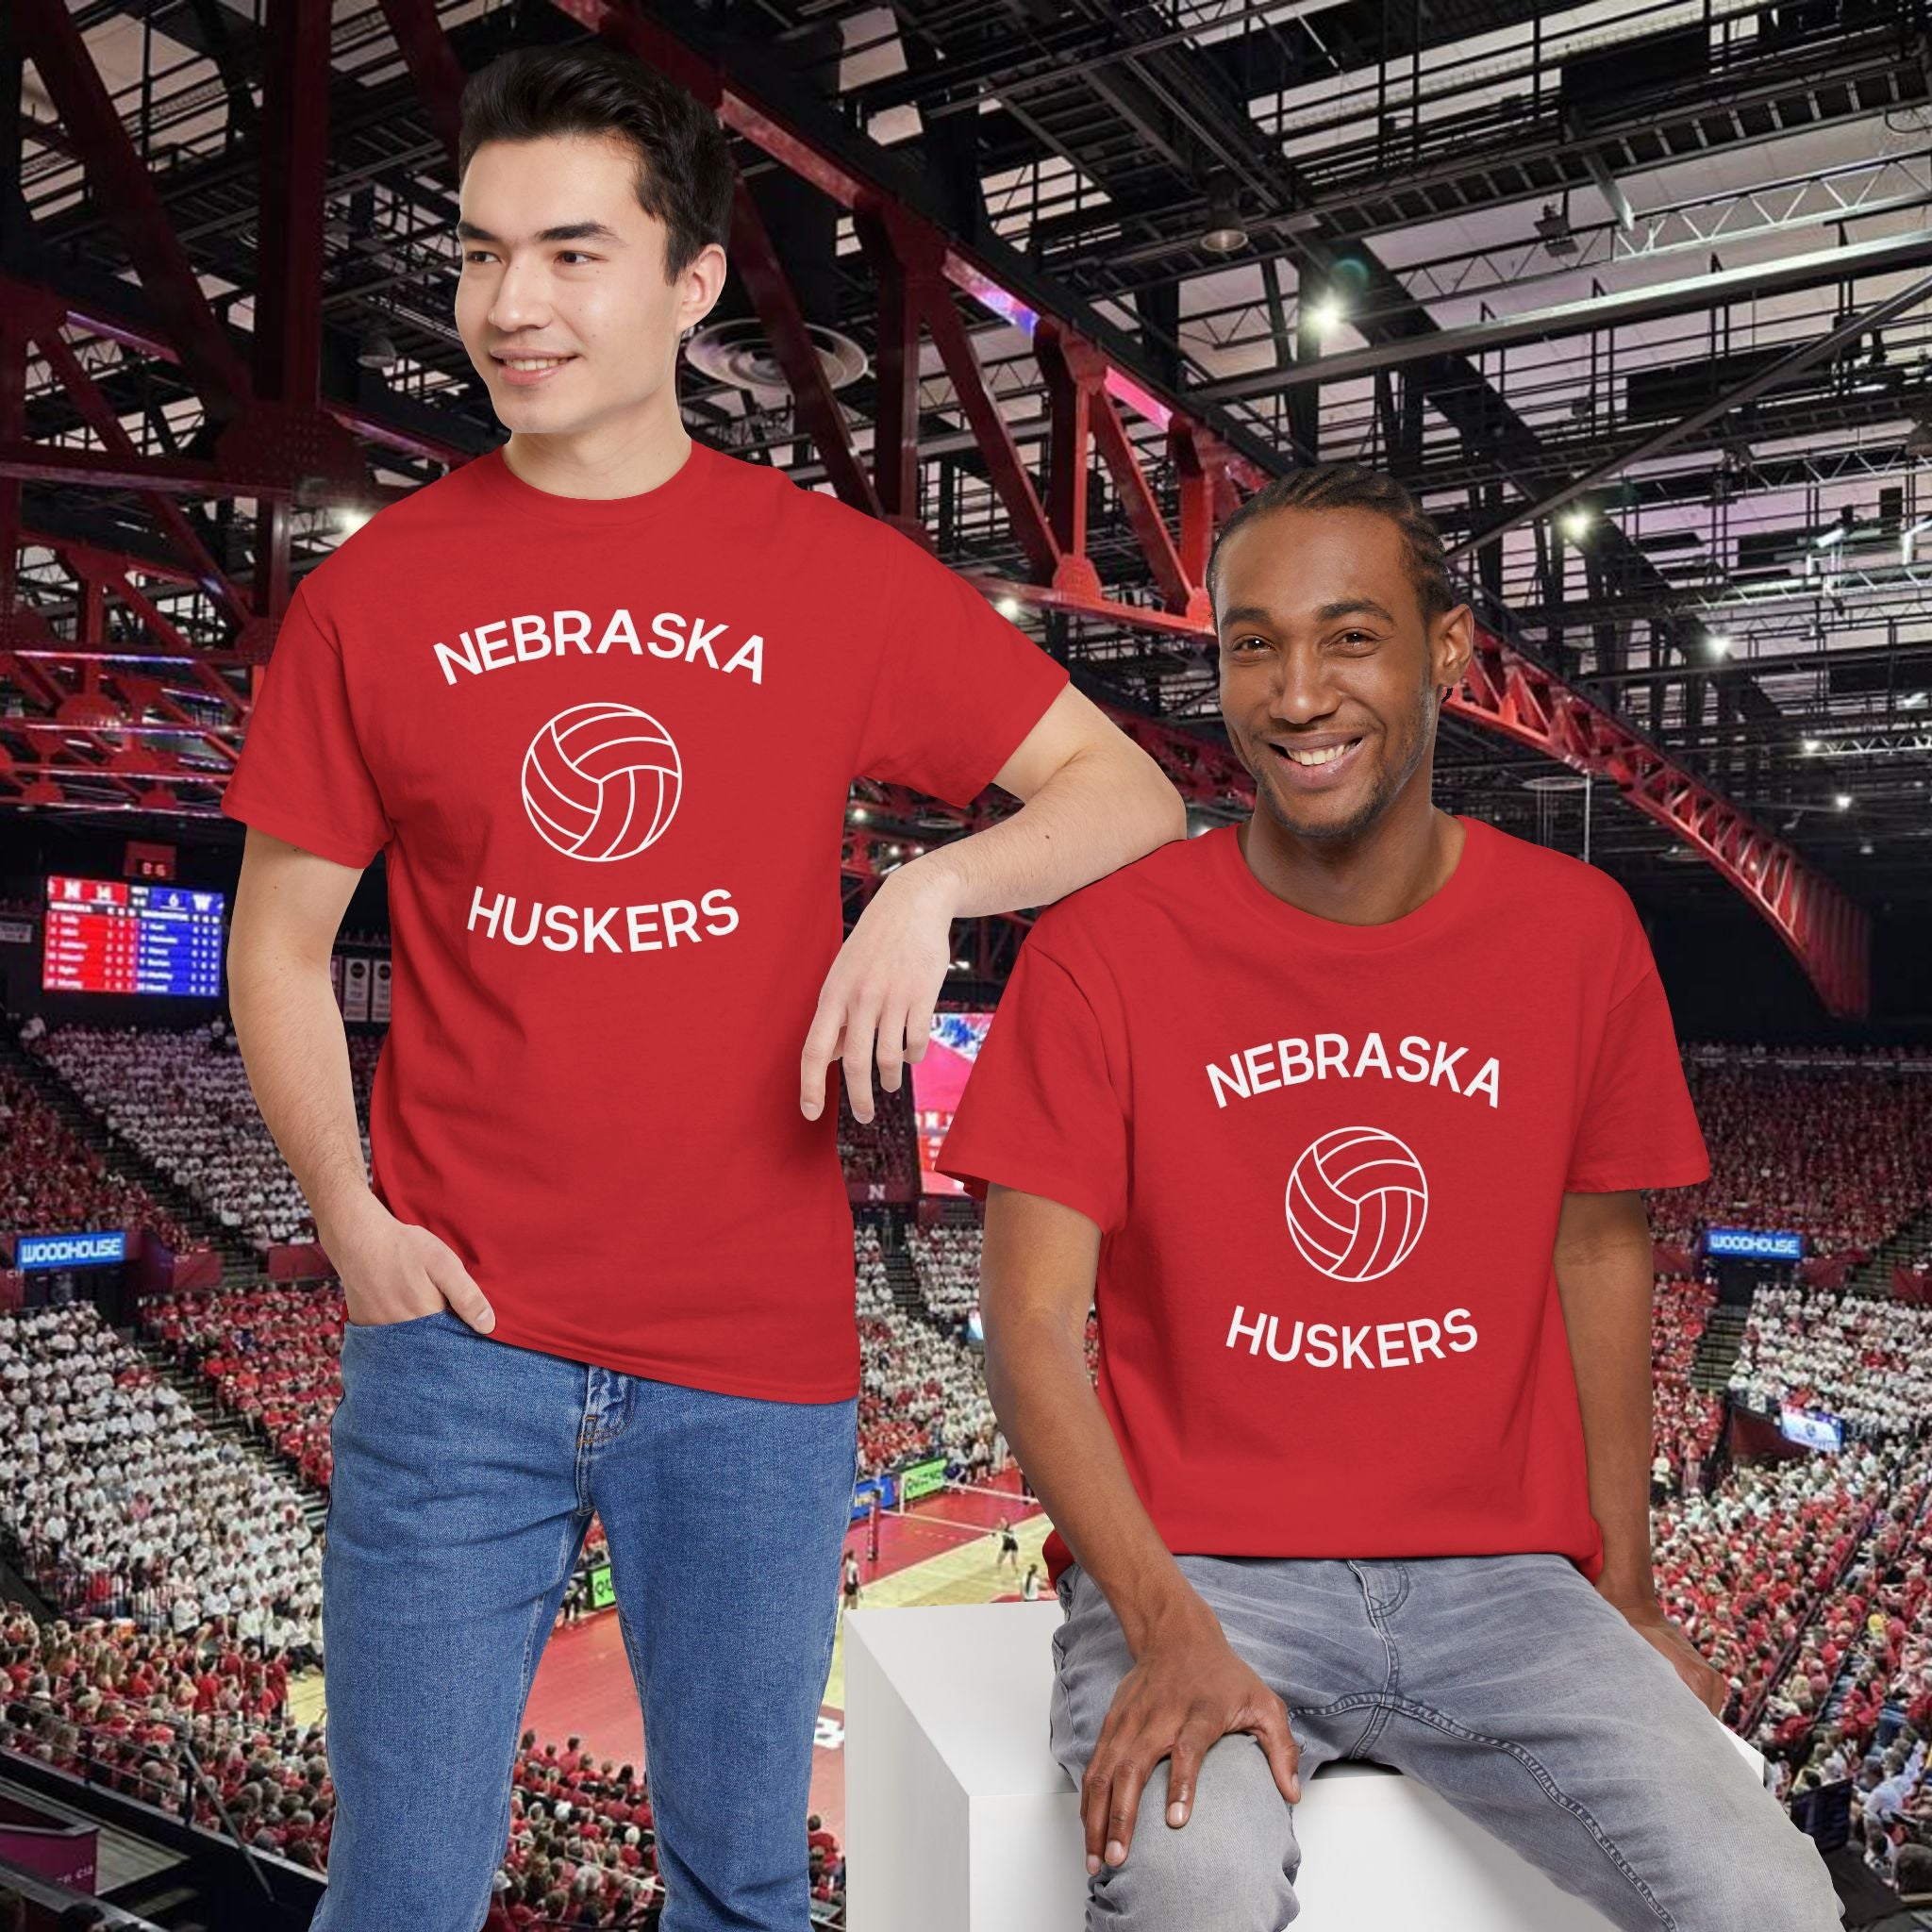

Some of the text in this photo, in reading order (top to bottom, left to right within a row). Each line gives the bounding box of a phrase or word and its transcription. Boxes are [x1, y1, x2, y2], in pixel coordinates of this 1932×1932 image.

[434, 609, 763, 685] NEBRASKA
[467, 886, 740, 954] HUSKERS
[1206, 1032, 1500, 1108] NEBRASKA
[869, 1184, 885, 1200] N
[22, 1238, 122, 1263] WOODHOUSE
[1709, 1234, 1798, 1255] WOODHOUSE
[1225, 1305, 1478, 1370] HUSKERS
